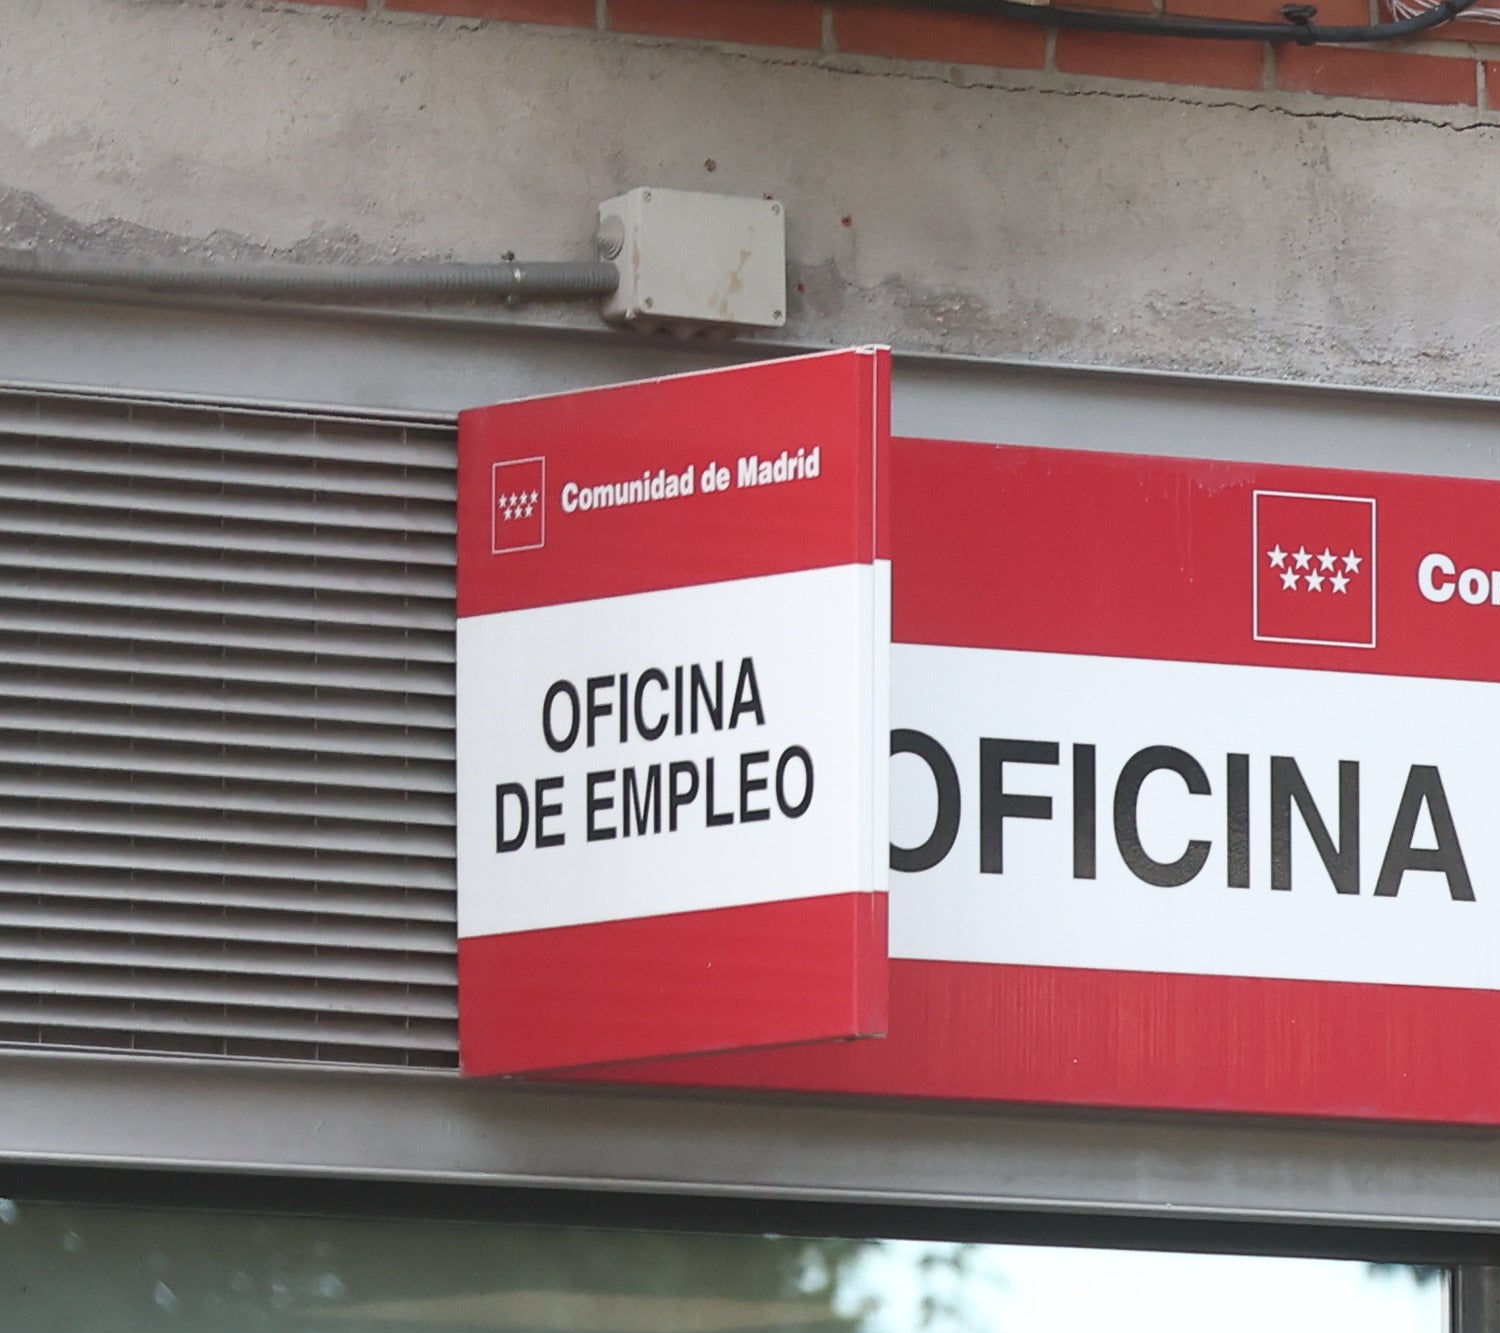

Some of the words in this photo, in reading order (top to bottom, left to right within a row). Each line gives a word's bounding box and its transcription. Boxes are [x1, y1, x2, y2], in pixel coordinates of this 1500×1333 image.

[560, 467, 694, 514] Comunidad
[700, 464, 731, 494] de
[737, 446, 820, 488] Madrid
[541, 656, 765, 754] OFICINA
[495, 776, 566, 853] DE
[585, 744, 814, 844] EMPLEO
[888, 728, 1476, 902] OFICINA
